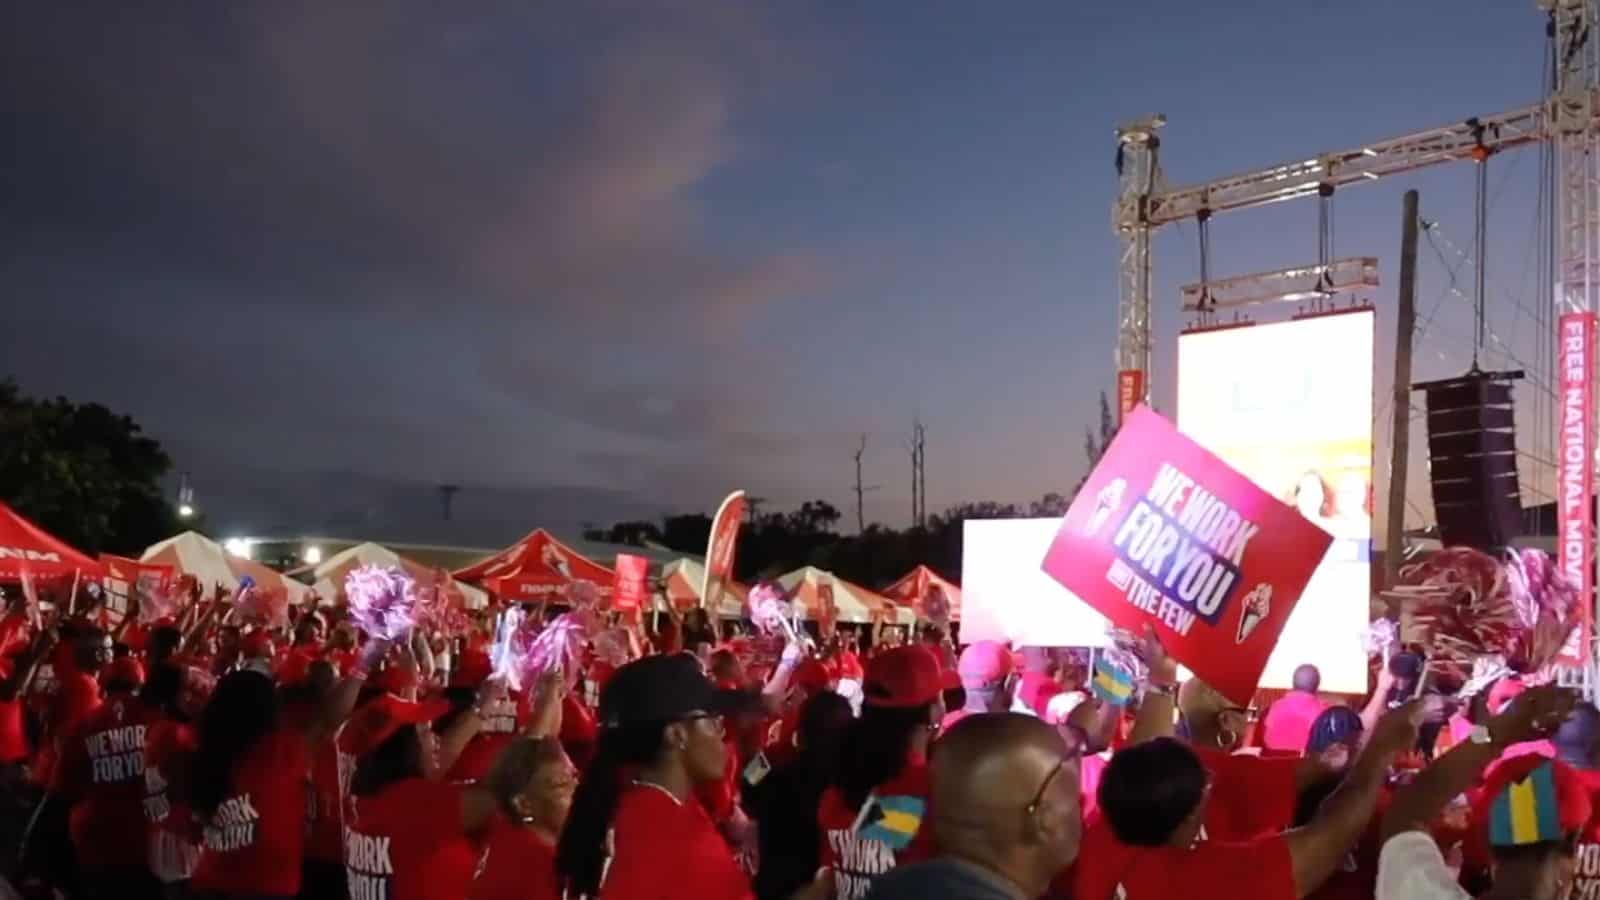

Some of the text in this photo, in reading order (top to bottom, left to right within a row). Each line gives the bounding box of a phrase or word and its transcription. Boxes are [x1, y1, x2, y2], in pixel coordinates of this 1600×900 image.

[1565, 321, 1584, 381] FREE
[1565, 387, 1584, 512] NATIONAL
[1147, 463, 1259, 567] WE WORK
[1114, 502, 1179, 577] FOR
[1164, 539, 1235, 617] YOU
[1126, 575, 1161, 618] THE
[1156, 598, 1197, 636] FEW
[85, 723, 147, 758] WE WOR
[93, 754, 125, 784] FOR
